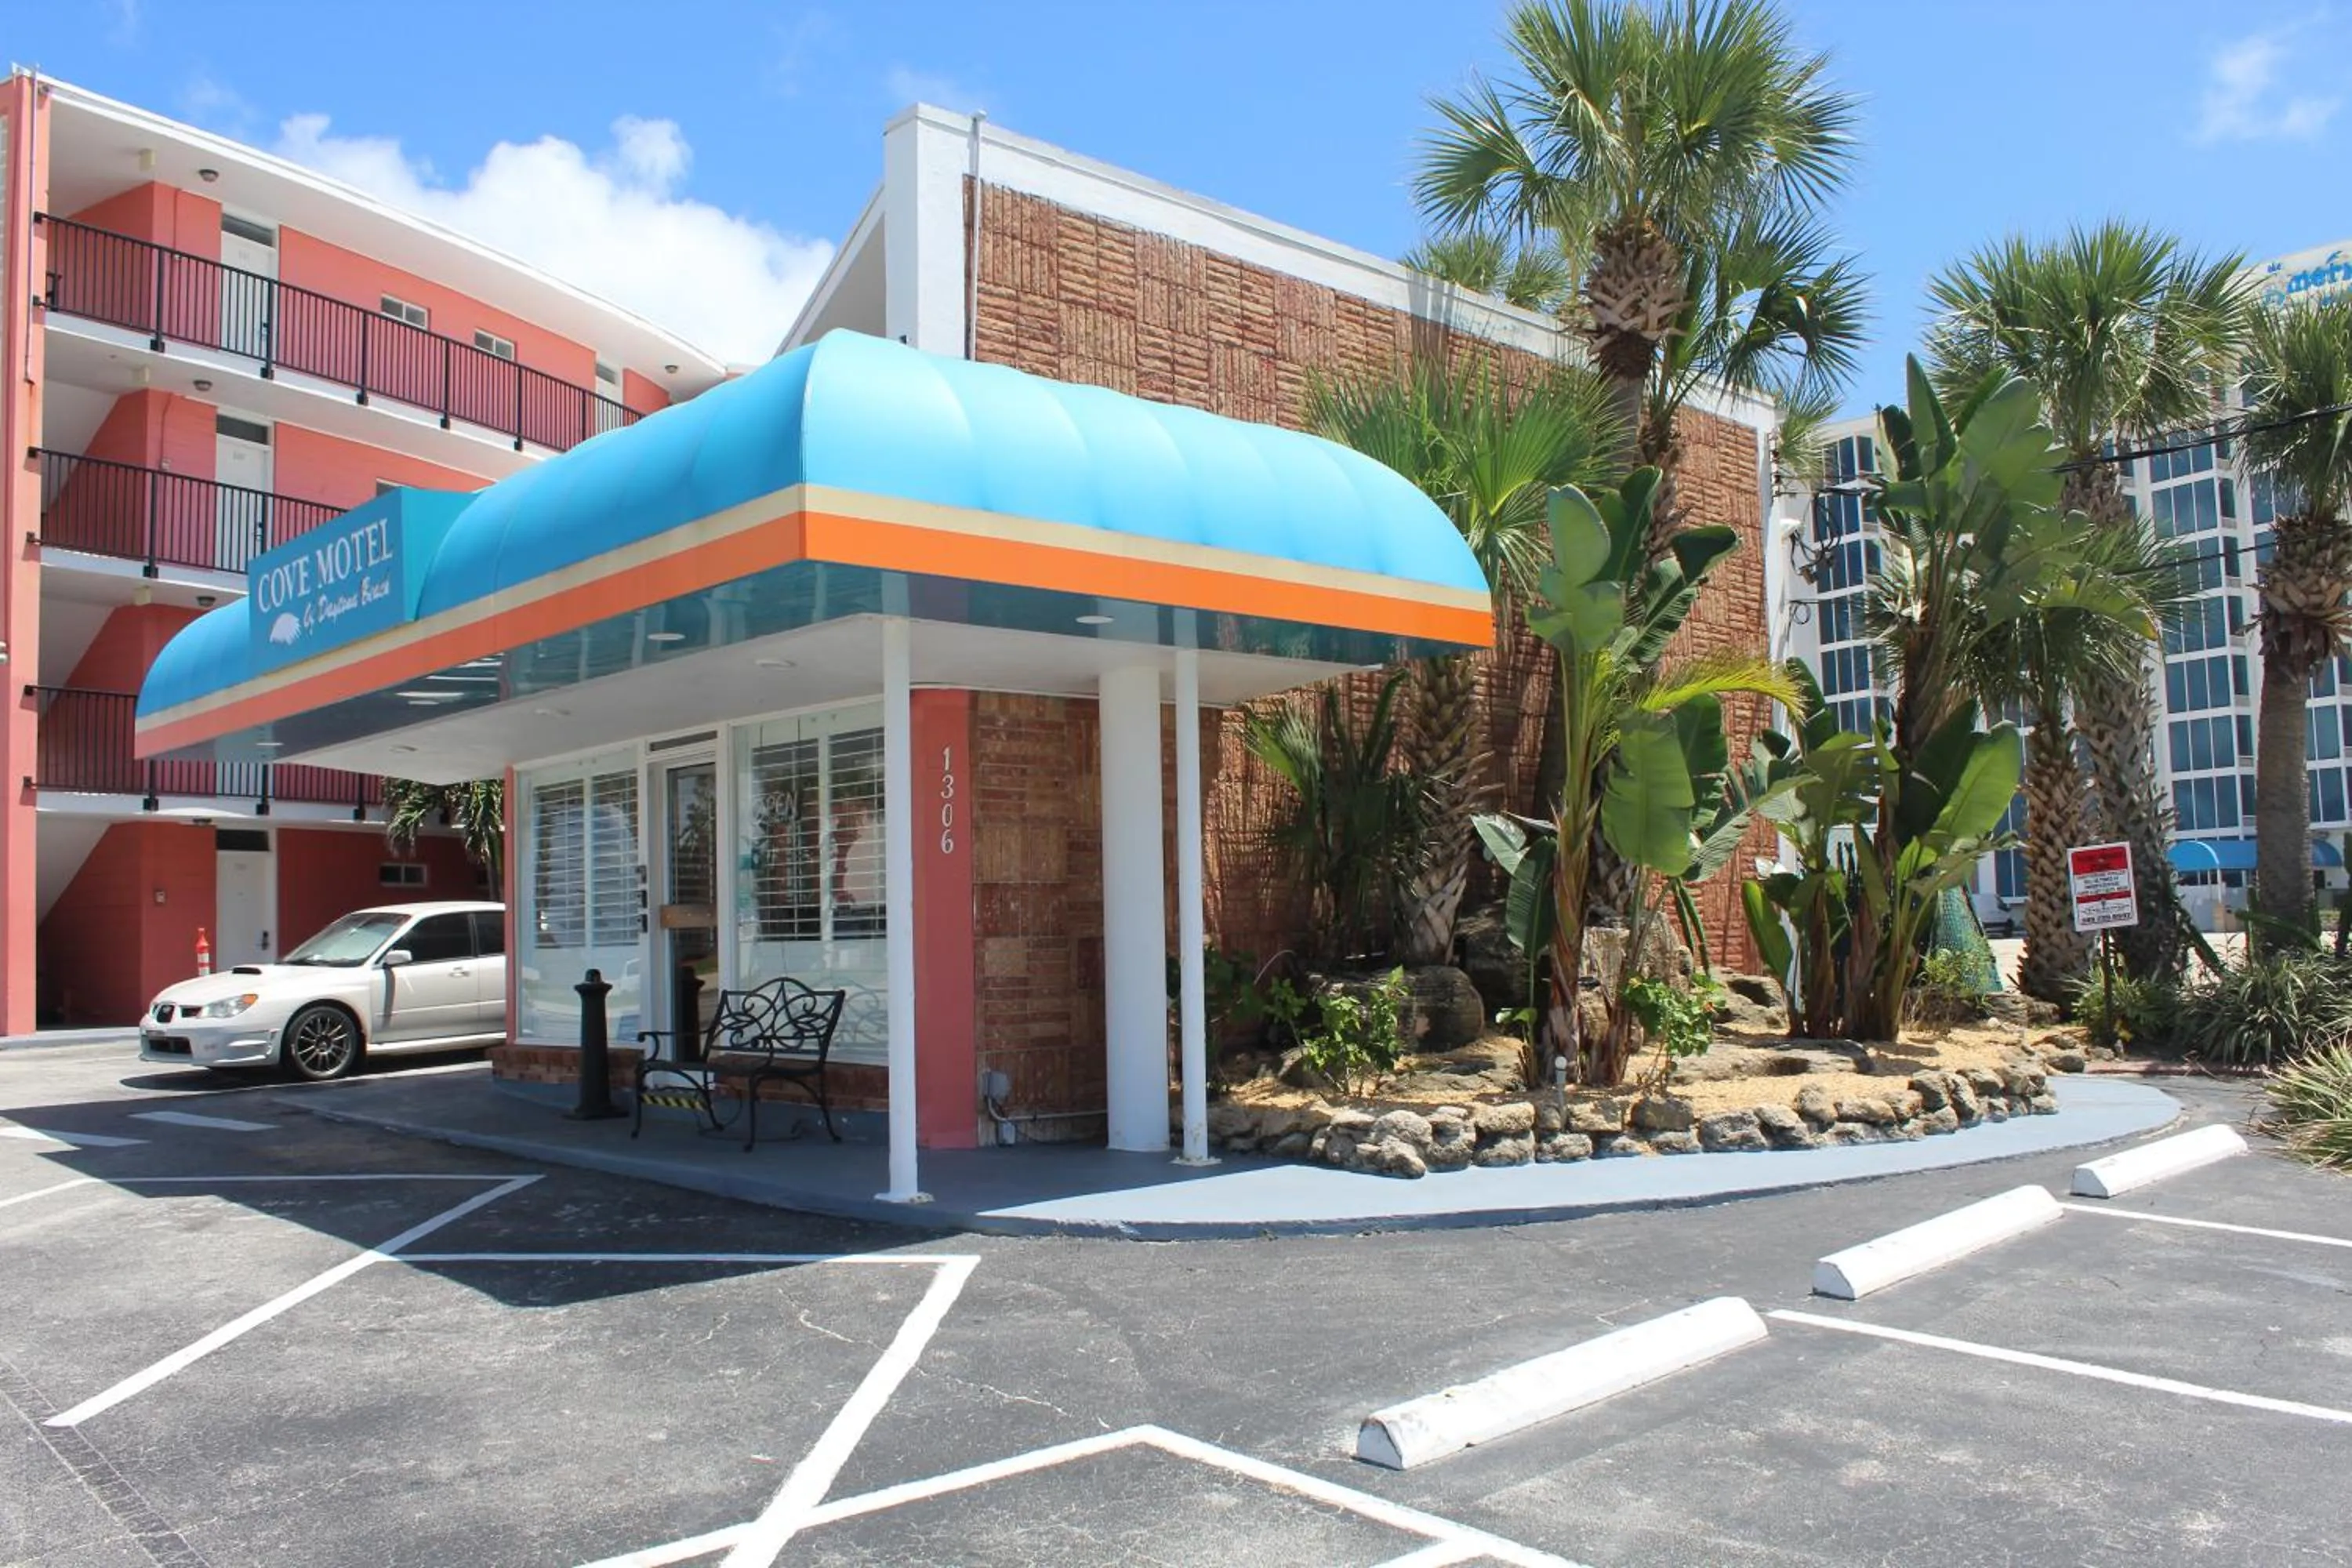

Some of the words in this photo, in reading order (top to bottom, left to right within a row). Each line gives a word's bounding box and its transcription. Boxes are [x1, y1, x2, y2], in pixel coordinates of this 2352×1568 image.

[258, 556, 310, 613] COVE
[317, 517, 392, 588] MOTEL
[941, 746, 954, 854] 1306
